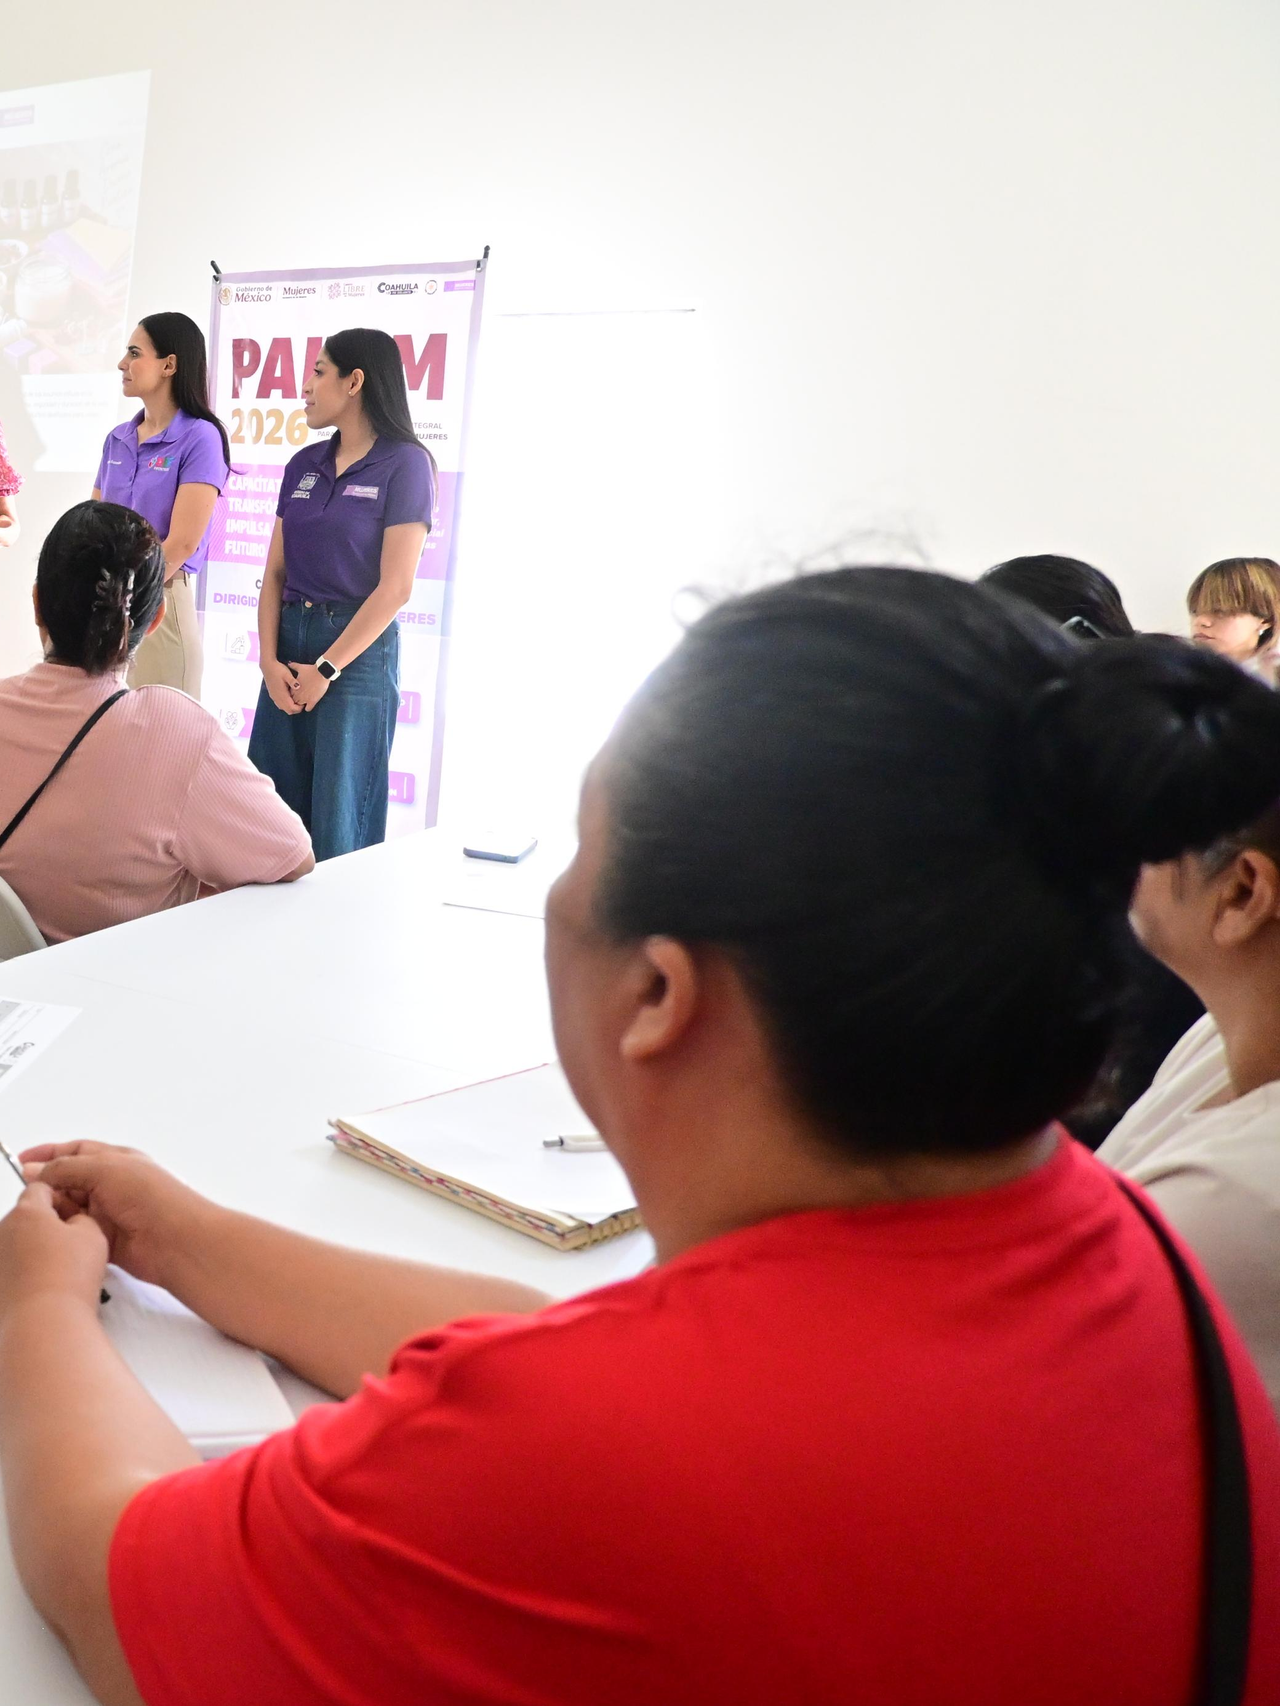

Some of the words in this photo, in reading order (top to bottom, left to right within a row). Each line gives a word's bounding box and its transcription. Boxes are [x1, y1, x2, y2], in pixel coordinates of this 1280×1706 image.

[236, 285, 265, 293] Gobierno
[265, 284, 273, 292] de
[282, 285, 317, 297] Mujeres
[343, 285, 366, 293] LIBRE
[377, 281, 419, 294] COAHUILA
[234, 291, 272, 303] México
[230, 407, 309, 446] 2026
[413, 422, 443, 430] TEGRAL
[228, 474, 282, 493] CAPACÍTAT
[226, 518, 271, 537] IMPULSA
[224, 540, 266, 558] FUTURO
[213, 592, 259, 608] DIRIGID
[398, 611, 436, 626] ERES
